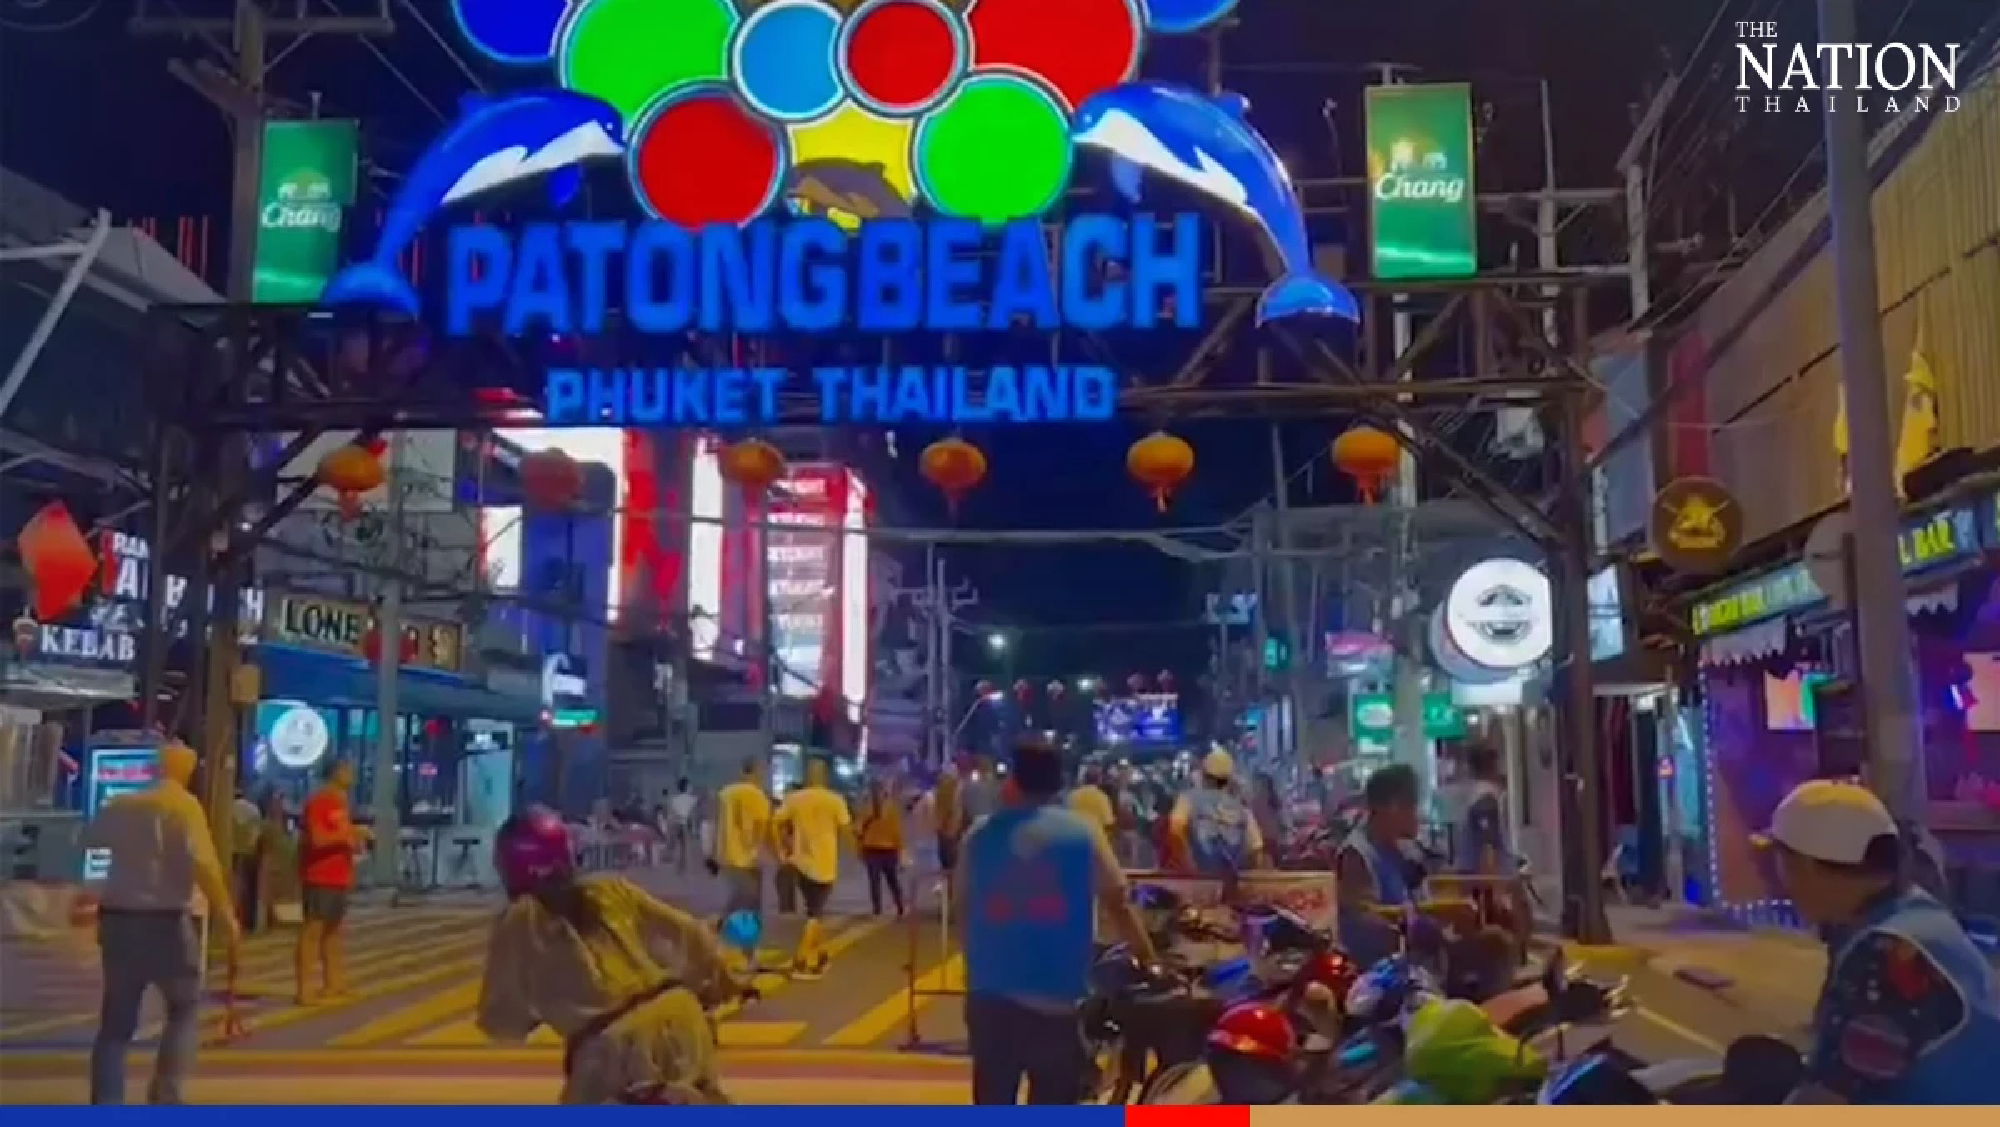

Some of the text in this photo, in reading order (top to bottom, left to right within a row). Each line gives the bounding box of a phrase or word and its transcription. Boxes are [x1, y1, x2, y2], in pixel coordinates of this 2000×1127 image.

[1374, 170, 1465, 204] Chang
[261, 201, 341, 234] Chang
[546, 366, 1117, 424] PHUKET THAILAND
[281, 597, 360, 646] LONE
[40, 623, 136, 661] KEBAB
